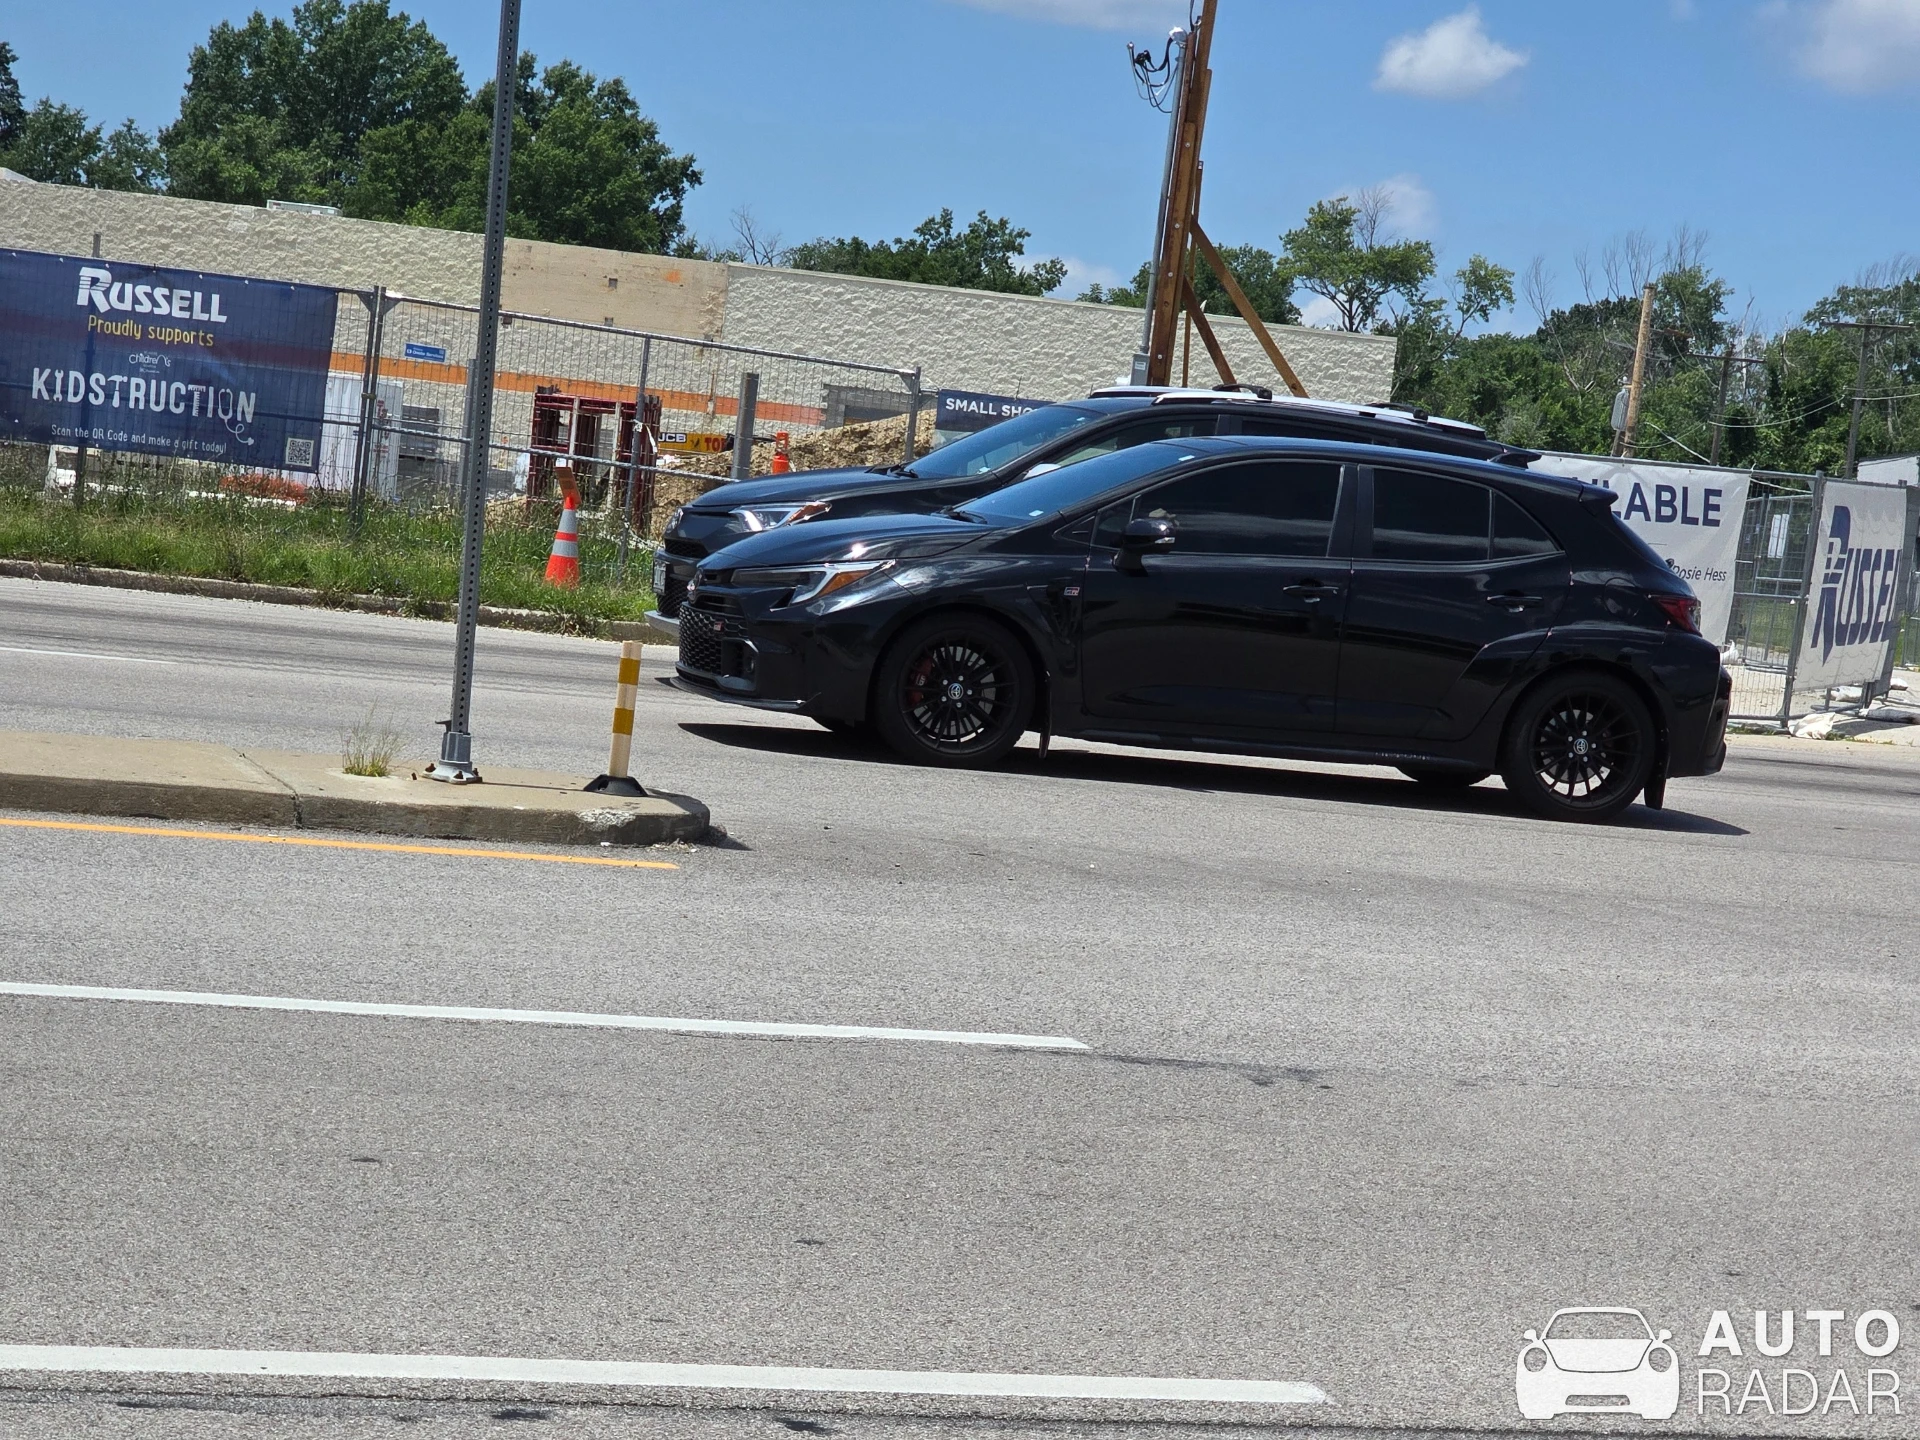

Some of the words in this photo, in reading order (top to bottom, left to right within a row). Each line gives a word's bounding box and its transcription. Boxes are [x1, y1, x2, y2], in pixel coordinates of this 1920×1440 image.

[77, 267, 227, 323] RUSSELL
[88, 315, 142, 340] Proudly
[148, 326, 214, 346] supports
[31, 367, 256, 423] KIDSTRUCTION
[945, 398, 997, 415] SMALL
[1001, 404, 1039, 418] SHO
[51, 424, 71, 436] Scan
[75, 427, 89, 438] the
[92, 428, 105, 440] QR
[107, 430, 128, 441] Code
[131, 434, 146, 444] and
[148, 436, 171, 447] make
[174, 439, 179, 448] a
[181, 439, 198, 450] gift
[658, 433, 686, 443] JCB
[1573, 476, 1723, 527] ABLE
[1704, 567, 1727, 581] Hess
